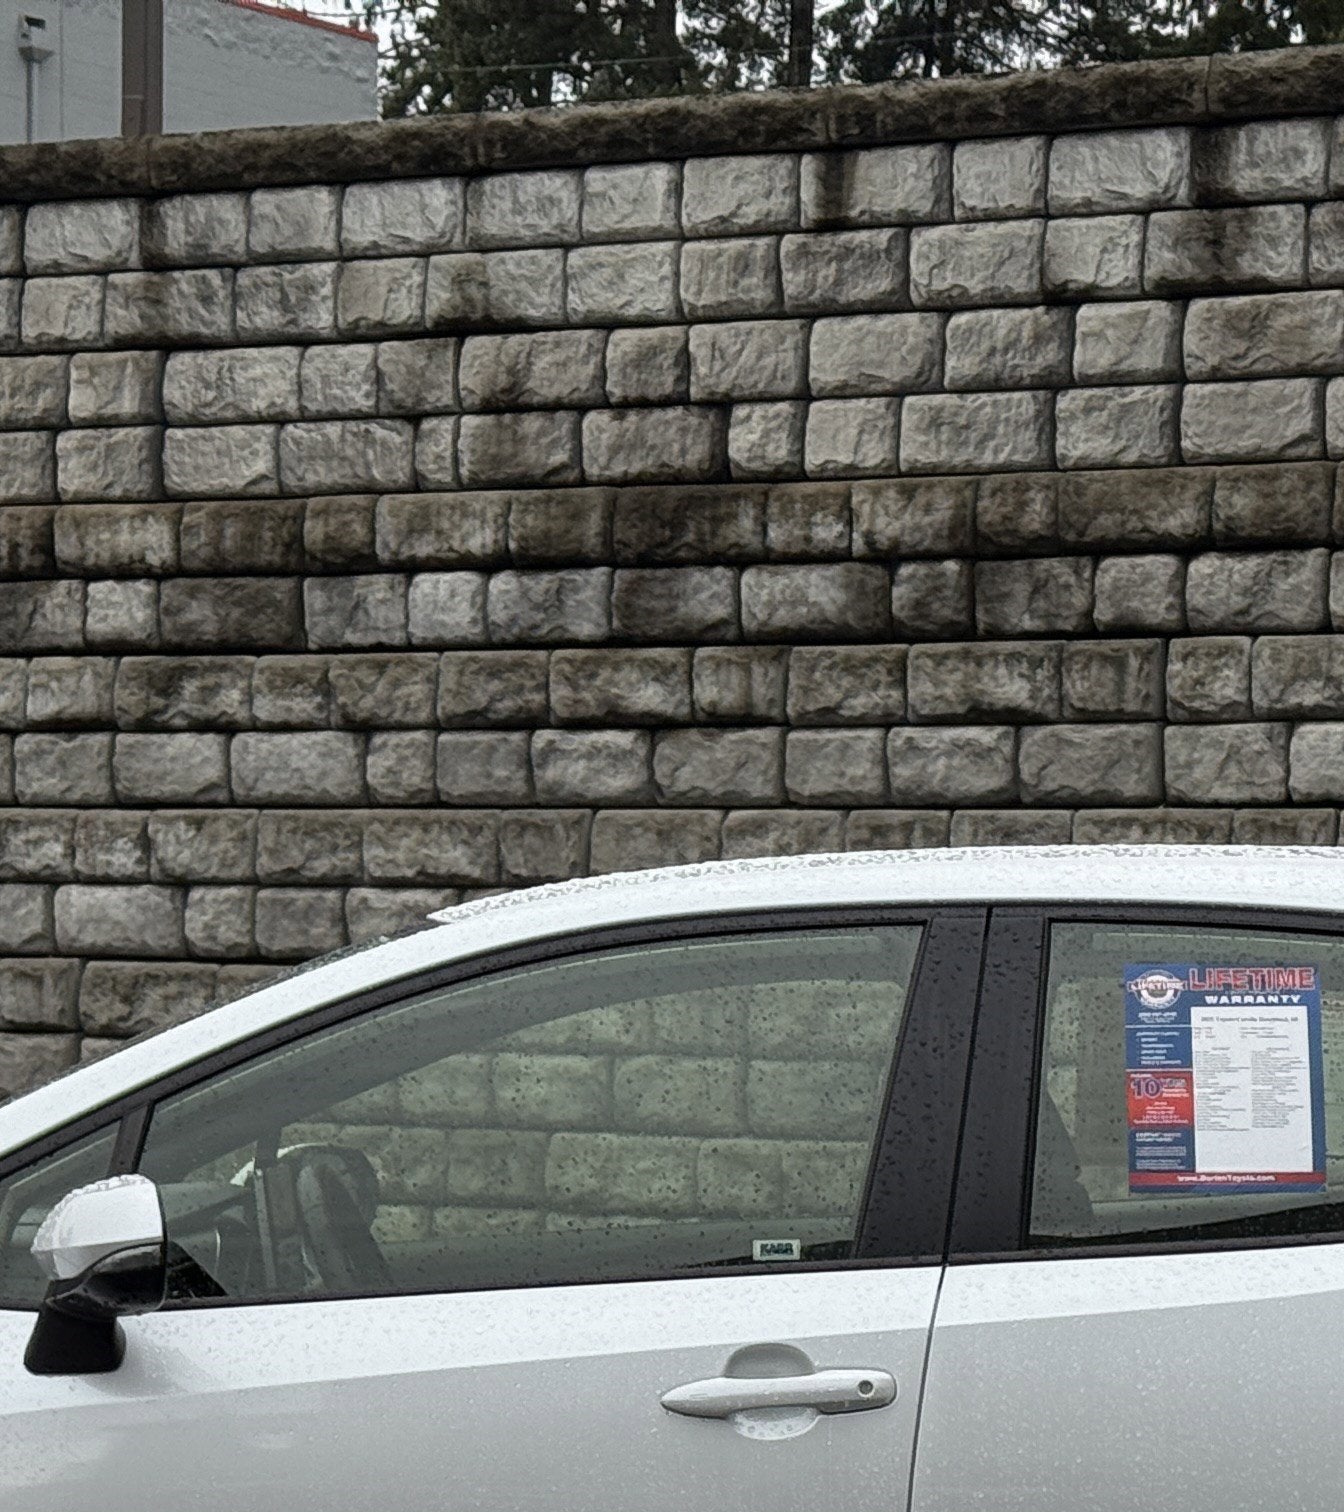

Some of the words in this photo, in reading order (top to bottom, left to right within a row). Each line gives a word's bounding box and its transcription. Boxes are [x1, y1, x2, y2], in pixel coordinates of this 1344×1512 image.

[1189, 967, 1315, 991] LIFETIME
[1204, 995, 1301, 1005] WARRANTY
[1131, 1078, 1162, 1099] 10
